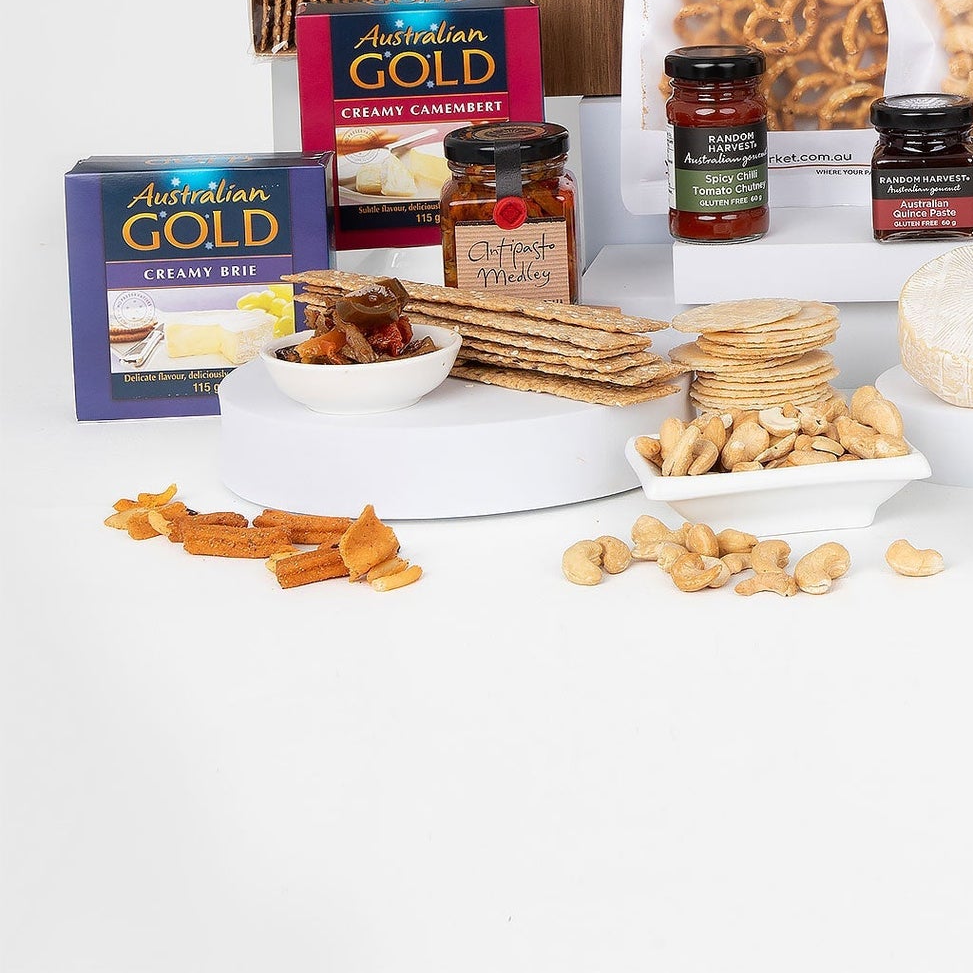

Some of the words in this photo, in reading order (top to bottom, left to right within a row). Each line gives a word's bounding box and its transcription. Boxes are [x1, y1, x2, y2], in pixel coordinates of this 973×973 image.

[353, 20, 489, 49] Australian
[350, 48, 497, 90] GOLD
[341, 105, 404, 119] CREAMY
[410, 101, 502, 115] CAMEMBERT
[708, 131, 755, 144] RANDOM
[684, 152, 741, 165] Australian
[769, 153, 852, 164] rket.com.au
[705, 174, 734, 184] Spicy
[736, 170, 758, 181] Chilli
[879, 176, 920, 185] RANDOM
[127, 178, 271, 209] Australian
[692, 186, 733, 196] Tomato
[735, 180, 767, 194] Chutney
[887, 184, 929, 194] Australian
[358, 205, 380, 214] Subtle
[381, 204, 407, 213] flavour,
[408, 202, 440, 212] deliciousl
[699, 199, 730, 207] GLUTEN
[730, 197, 748, 205] FREE
[900, 199, 949, 209] Australian
[416, 213, 433, 223] 115
[892, 209, 928, 218] Quince
[929, 209, 957, 217] Paste
[121, 208, 279, 251] GOLD
[893, 220, 920, 228] GLUTEN
[468, 233, 555, 270] Antipasto
[144, 266, 213, 280] CREAMY
[220, 265, 257, 277] BRIE
[477, 261, 551, 288] Medley
[124, 373, 157, 383] Delicate
[158, 372, 187, 381] flavour,
[192, 382, 211, 393] 115
